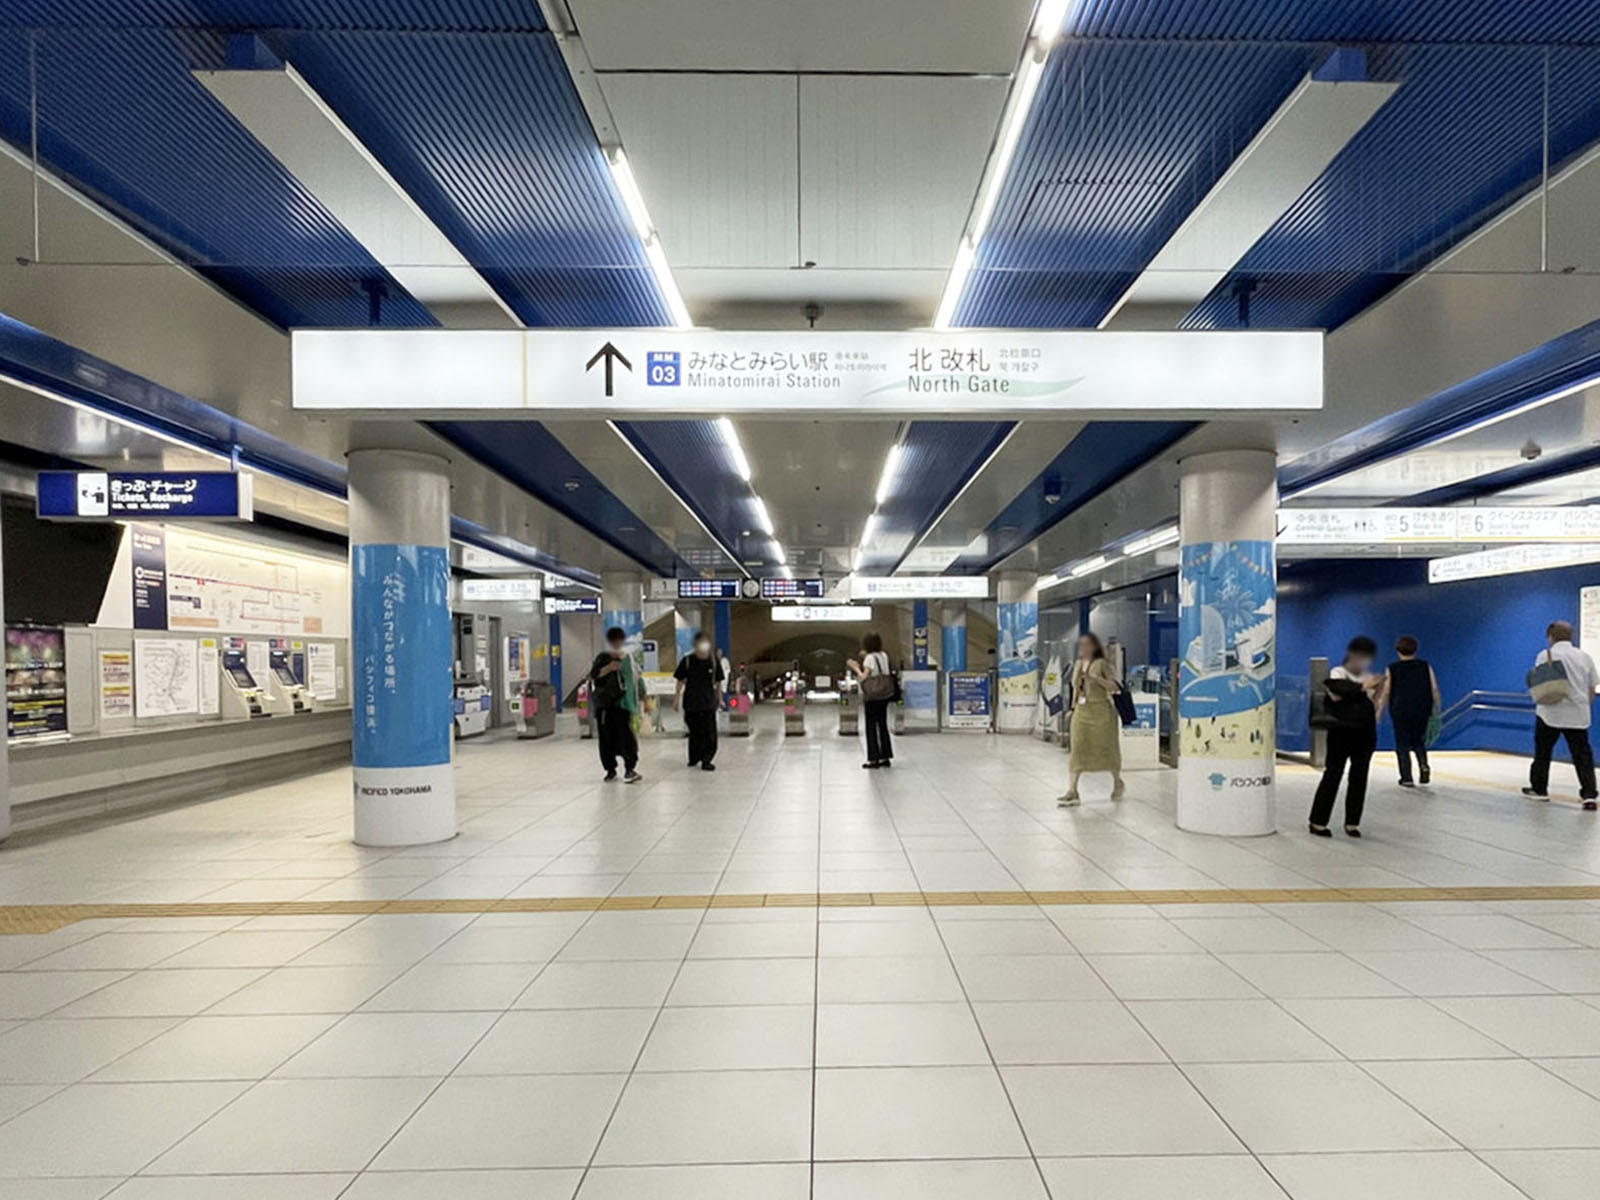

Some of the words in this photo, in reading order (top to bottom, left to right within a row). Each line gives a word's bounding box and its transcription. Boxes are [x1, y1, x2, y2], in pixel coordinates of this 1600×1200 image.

[688, 351, 829, 371] みなとみらい駅
[652, 365, 676, 383] 03
[688, 373, 781, 388] Minatomirai
[786, 373, 841, 388] Station
[908, 375, 960, 393] North
[968, 374, 1010, 393] Gate
[1399, 514, 1410, 533] 5
[1474, 514, 1485, 533] 6
[389, 785, 432, 797] YOKOHAMA
[1229, 776, 1272, 788] パシフィコ
